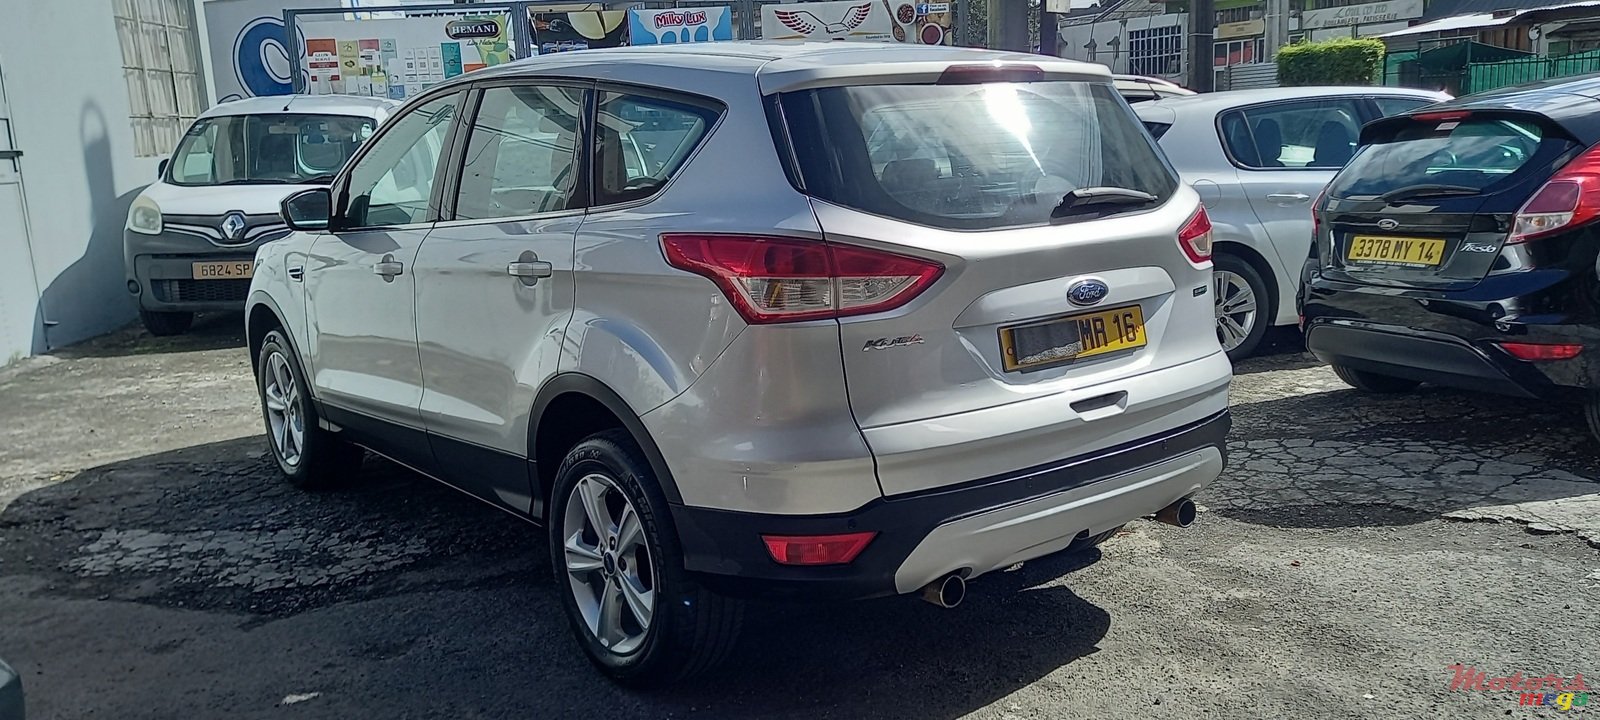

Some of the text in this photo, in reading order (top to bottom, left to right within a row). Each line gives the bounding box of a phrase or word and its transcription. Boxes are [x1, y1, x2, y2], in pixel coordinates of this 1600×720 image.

[654, 11, 707, 29] Milky Lux
[452, 24, 496, 34] HEMANI
[1356, 238, 1436, 262] 3378 MY 14
[201, 263, 250, 276] 6824 SP
[1079, 284, 1103, 300] Ford
[1079, 311, 1137, 351] MR 16
